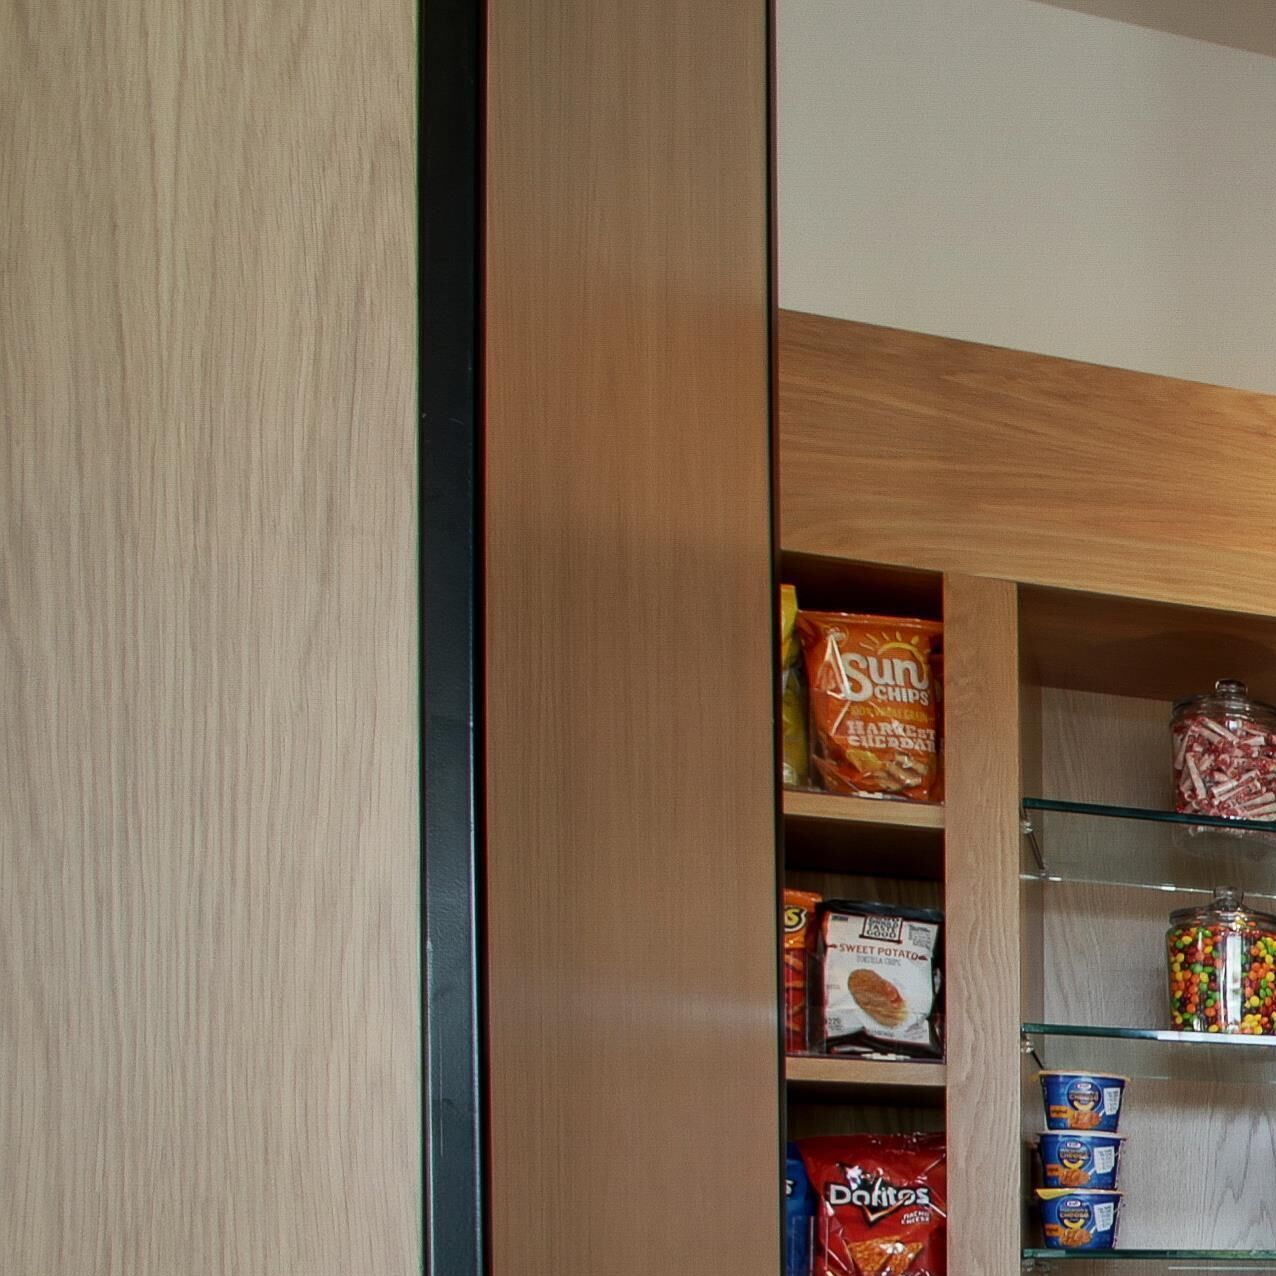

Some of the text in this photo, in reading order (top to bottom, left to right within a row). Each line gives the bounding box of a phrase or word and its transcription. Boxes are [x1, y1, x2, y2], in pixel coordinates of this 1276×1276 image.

[840, 652, 929, 702] Sun
[874, 686, 929, 706] CHIPS
[866, 930, 897, 939] GOOD
[839, 943, 919, 960] SWEET POTATO
[829, 1183, 931, 1207] Doritos
